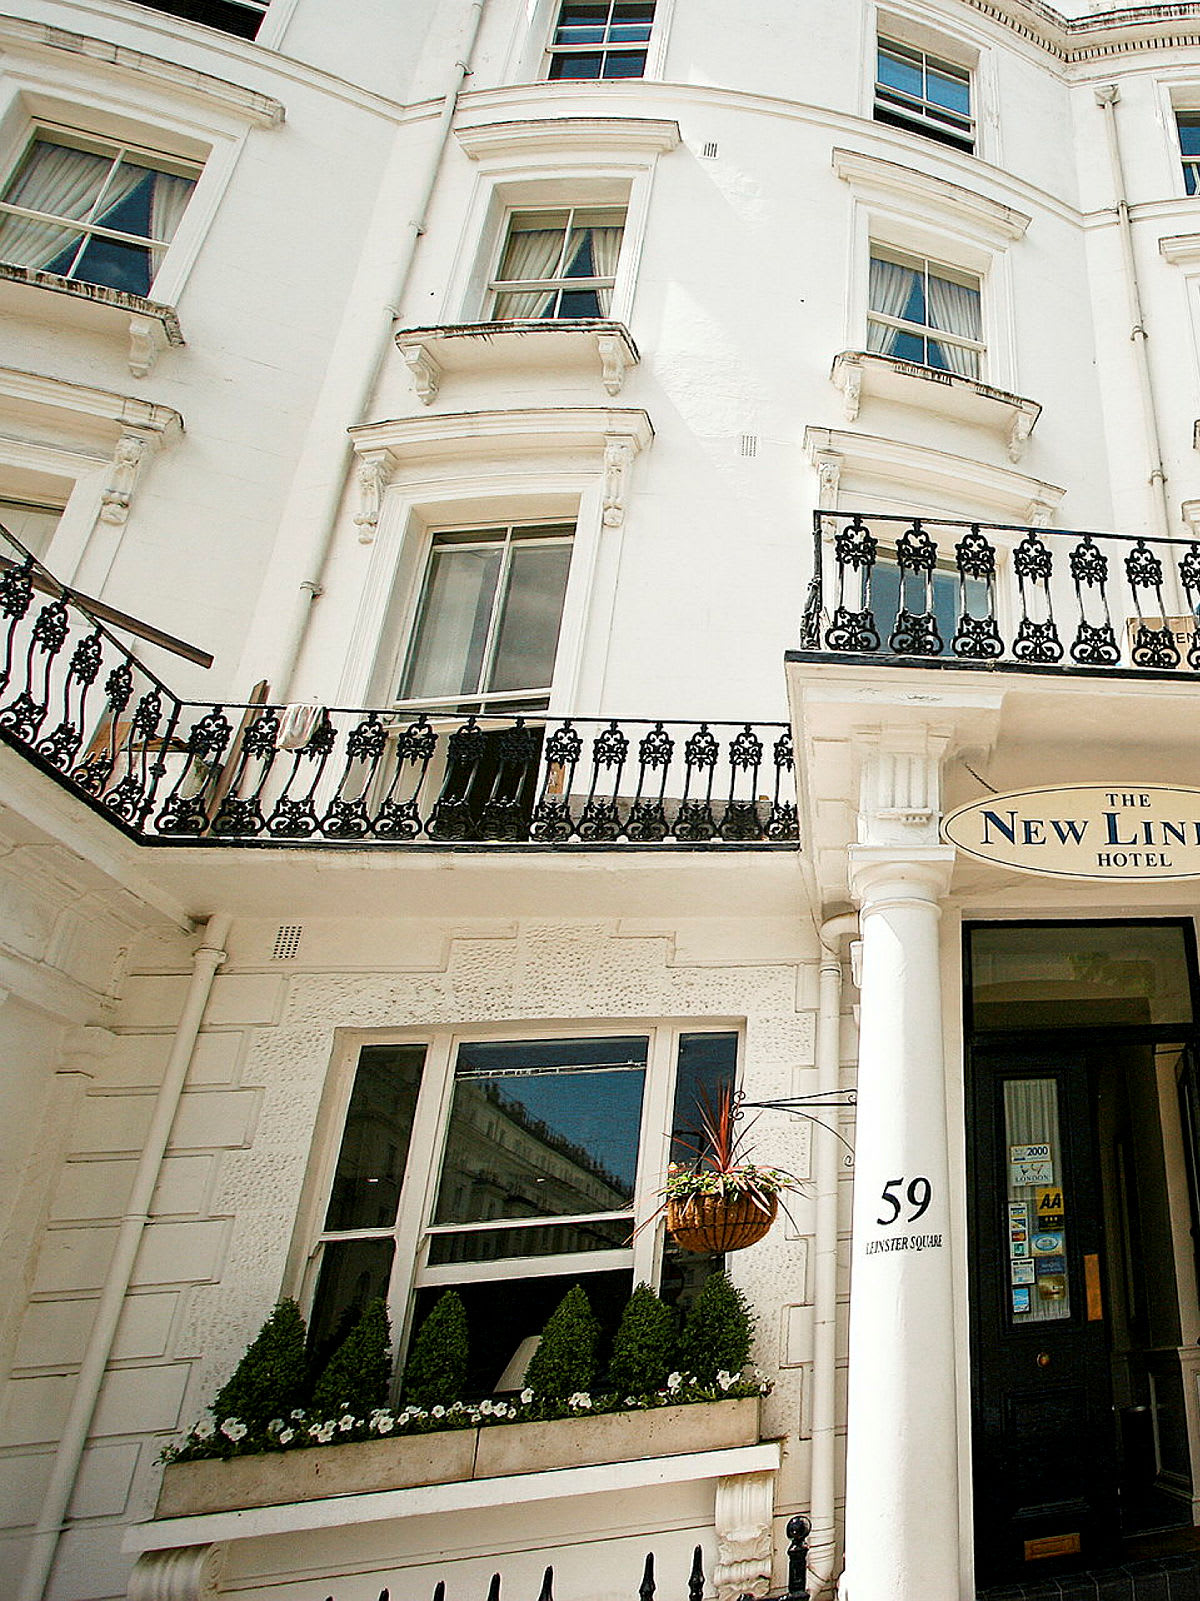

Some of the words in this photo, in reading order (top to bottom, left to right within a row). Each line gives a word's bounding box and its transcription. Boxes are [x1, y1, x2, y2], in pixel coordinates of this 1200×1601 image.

[1106, 793, 1151, 808] THE
[979, 810, 1089, 845] NEW
[1098, 852, 1173, 868] HOTEL
[1027, 1146, 1049, 1156] 2000
[1015, 1174, 1049, 1182] LONDON
[876, 1177, 932, 1226] 59
[1039, 1192, 1062, 1209] AA
[865, 1236, 909, 1255] LEINSTER
[909, 1234, 943, 1252] SQUARE
